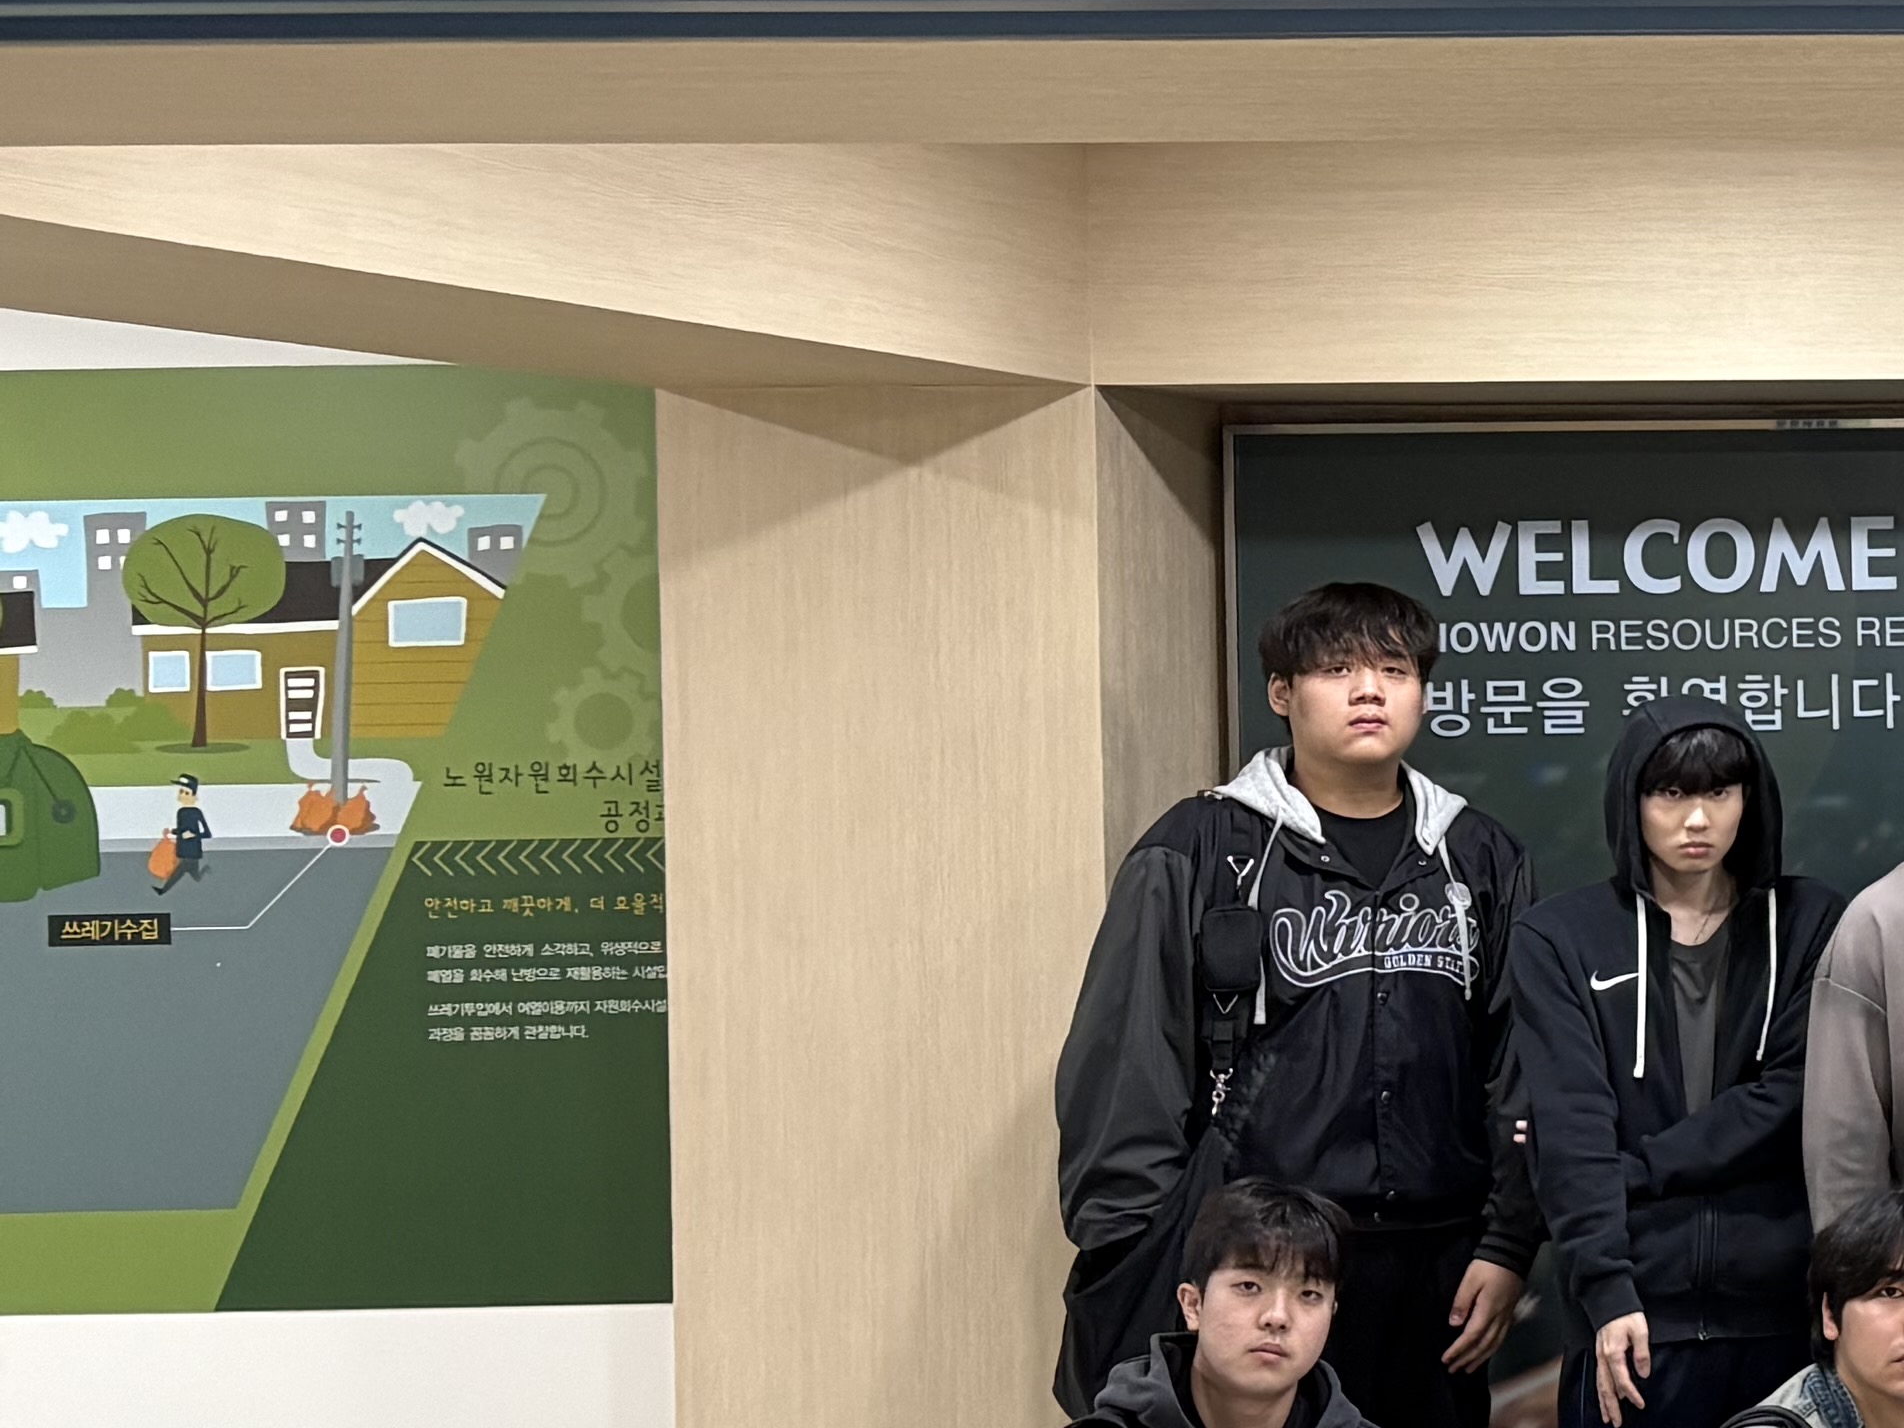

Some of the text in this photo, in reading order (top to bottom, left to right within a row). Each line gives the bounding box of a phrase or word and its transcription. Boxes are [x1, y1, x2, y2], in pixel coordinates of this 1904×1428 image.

[1416, 518, 1898, 596] WELCOME
[1439, 620, 1576, 653] OWON
[1591, 616, 1842, 652] RESOURCES
[1426, 677, 1590, 738] 방문을
[443, 760, 662, 795] 노원자원회수시설
[424, 897, 494, 919] 안전하고
[502, 894, 579, 917] 깨끗하게,
[589, 895, 605, 911] 더
[60, 918, 159, 941] 쓰레기수집
[426, 940, 663, 959] 폐기물을 안전하게 소각하고, 위생적으로
[426, 968, 465, 984] 폐열을
[469, 968, 508, 983] 회수해
[510, 967, 562, 982] 난방으로
[565, 965, 629, 981] 재활용하는
[1384, 954, 1469, 974] GOLDEN STAT
[427, 999, 667, 1017] 쓰레기투입에서 여열이용까지 자원회수시설
[428, 1024, 589, 1042] 과정을 꼼꼼하게 관찰합니다.
